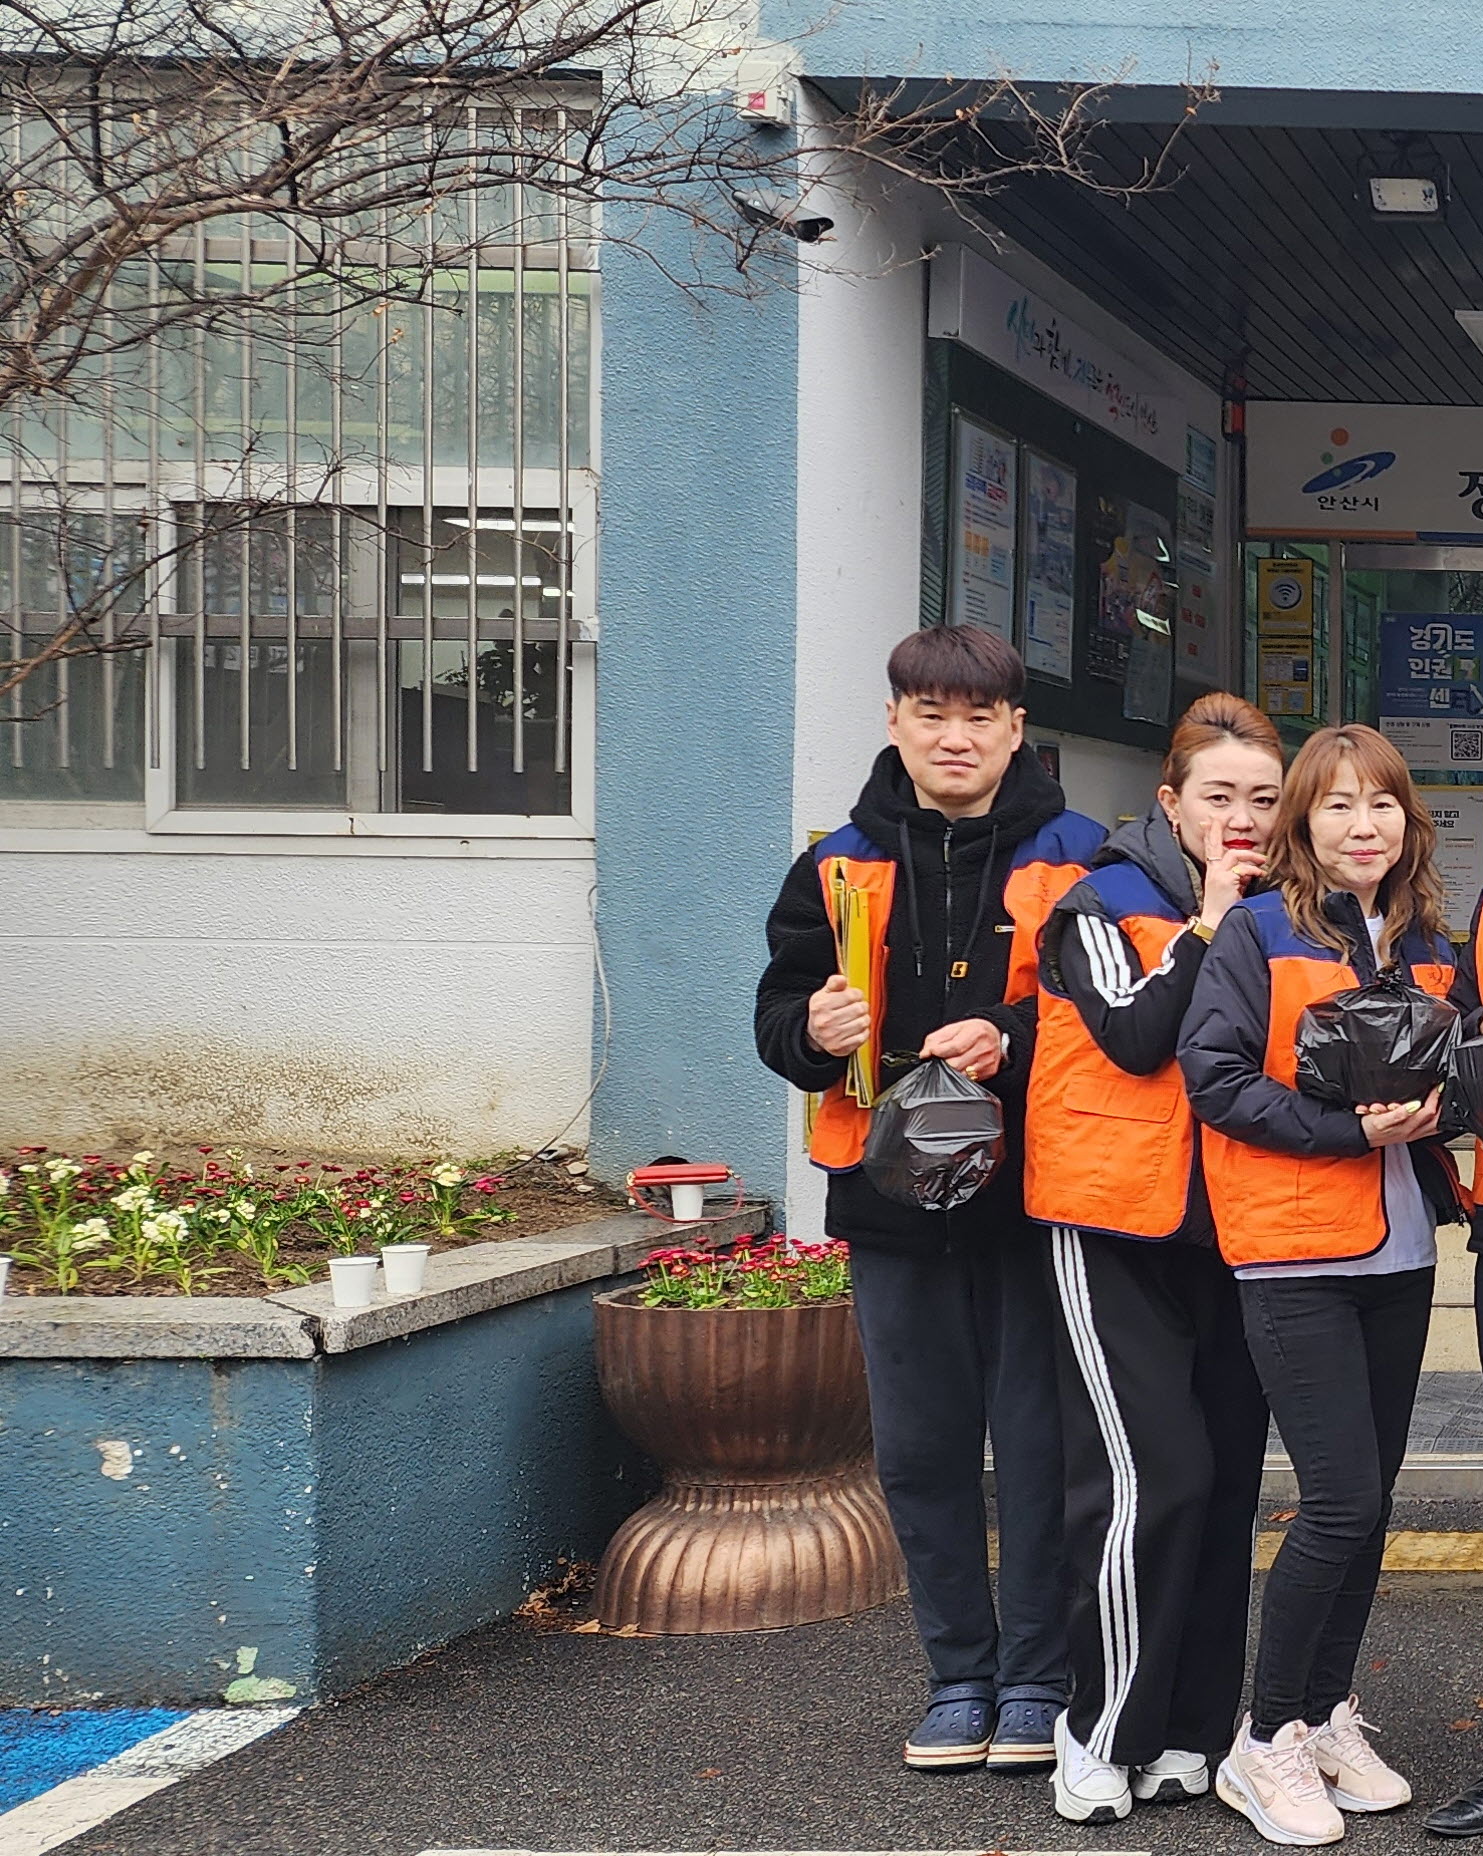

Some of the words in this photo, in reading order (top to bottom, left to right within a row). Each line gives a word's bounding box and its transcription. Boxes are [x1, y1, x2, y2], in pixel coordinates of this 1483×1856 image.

[1317, 495, 1380, 512] 안산시
[1409, 623, 1475, 651] 경기도
[1407, 657, 1453, 680] 인권
